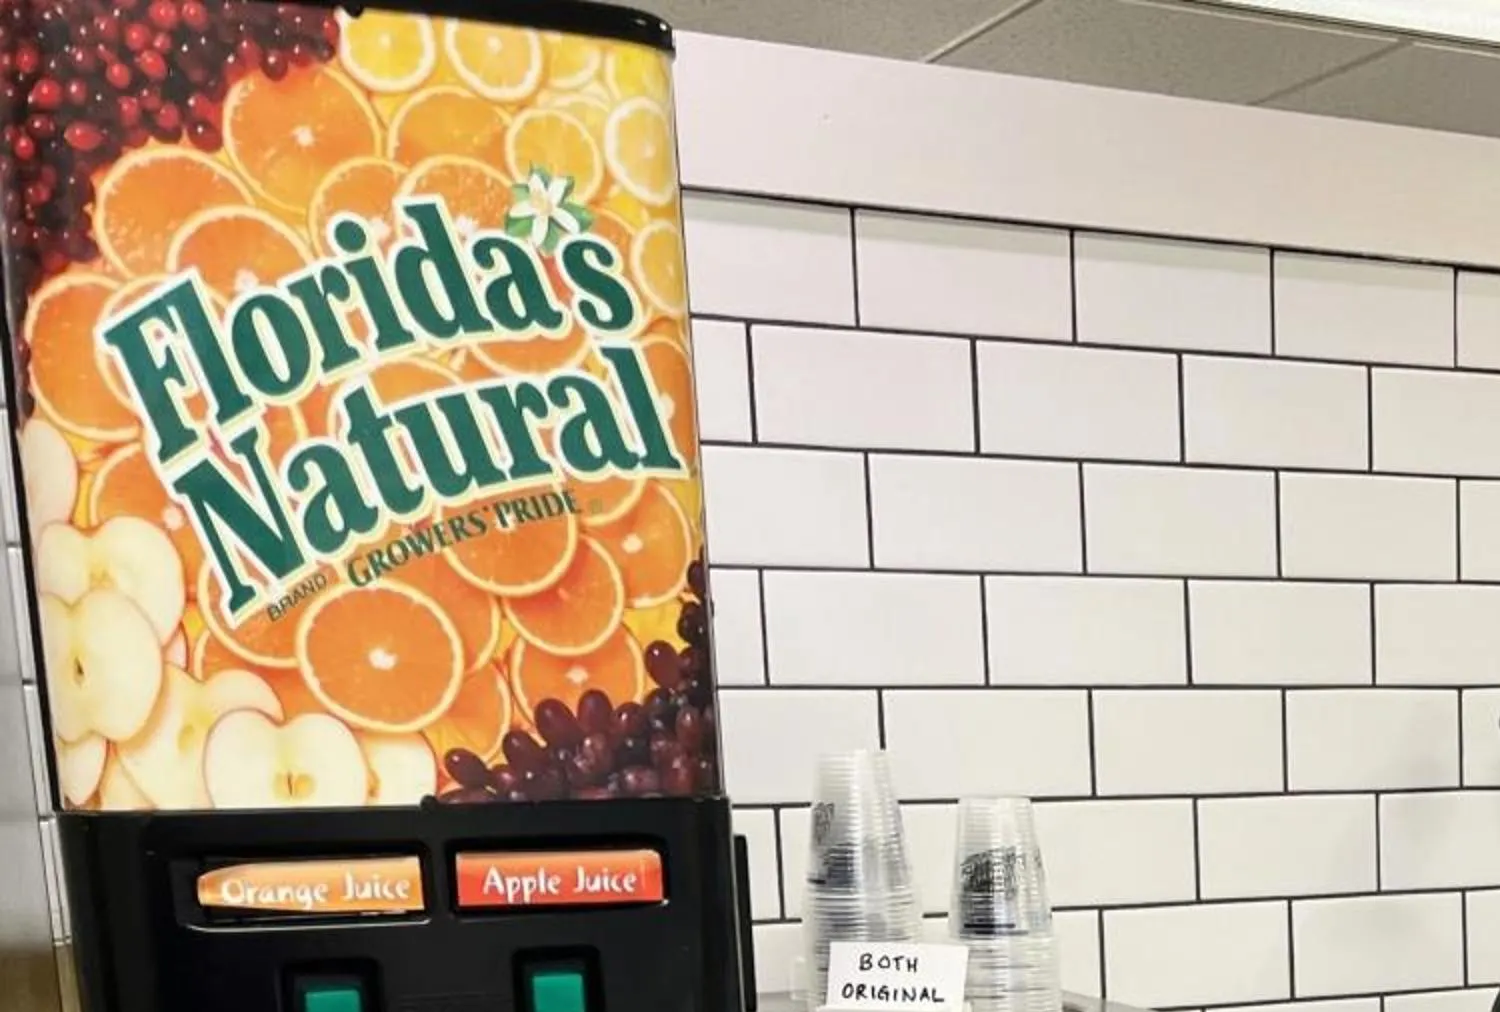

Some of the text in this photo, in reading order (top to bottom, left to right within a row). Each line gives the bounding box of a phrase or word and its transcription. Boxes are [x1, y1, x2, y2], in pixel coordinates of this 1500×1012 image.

[173, 345, 690, 613] Natural
[266, 574, 328, 622] BRAND
[493, 488, 582, 530] PRIDE
[221, 872, 410, 910] Orange Juice
[483, 864, 638, 904] Apple Juice
[858, 952, 919, 974] BOTH
[841, 982, 945, 1004] ORIGINAL
